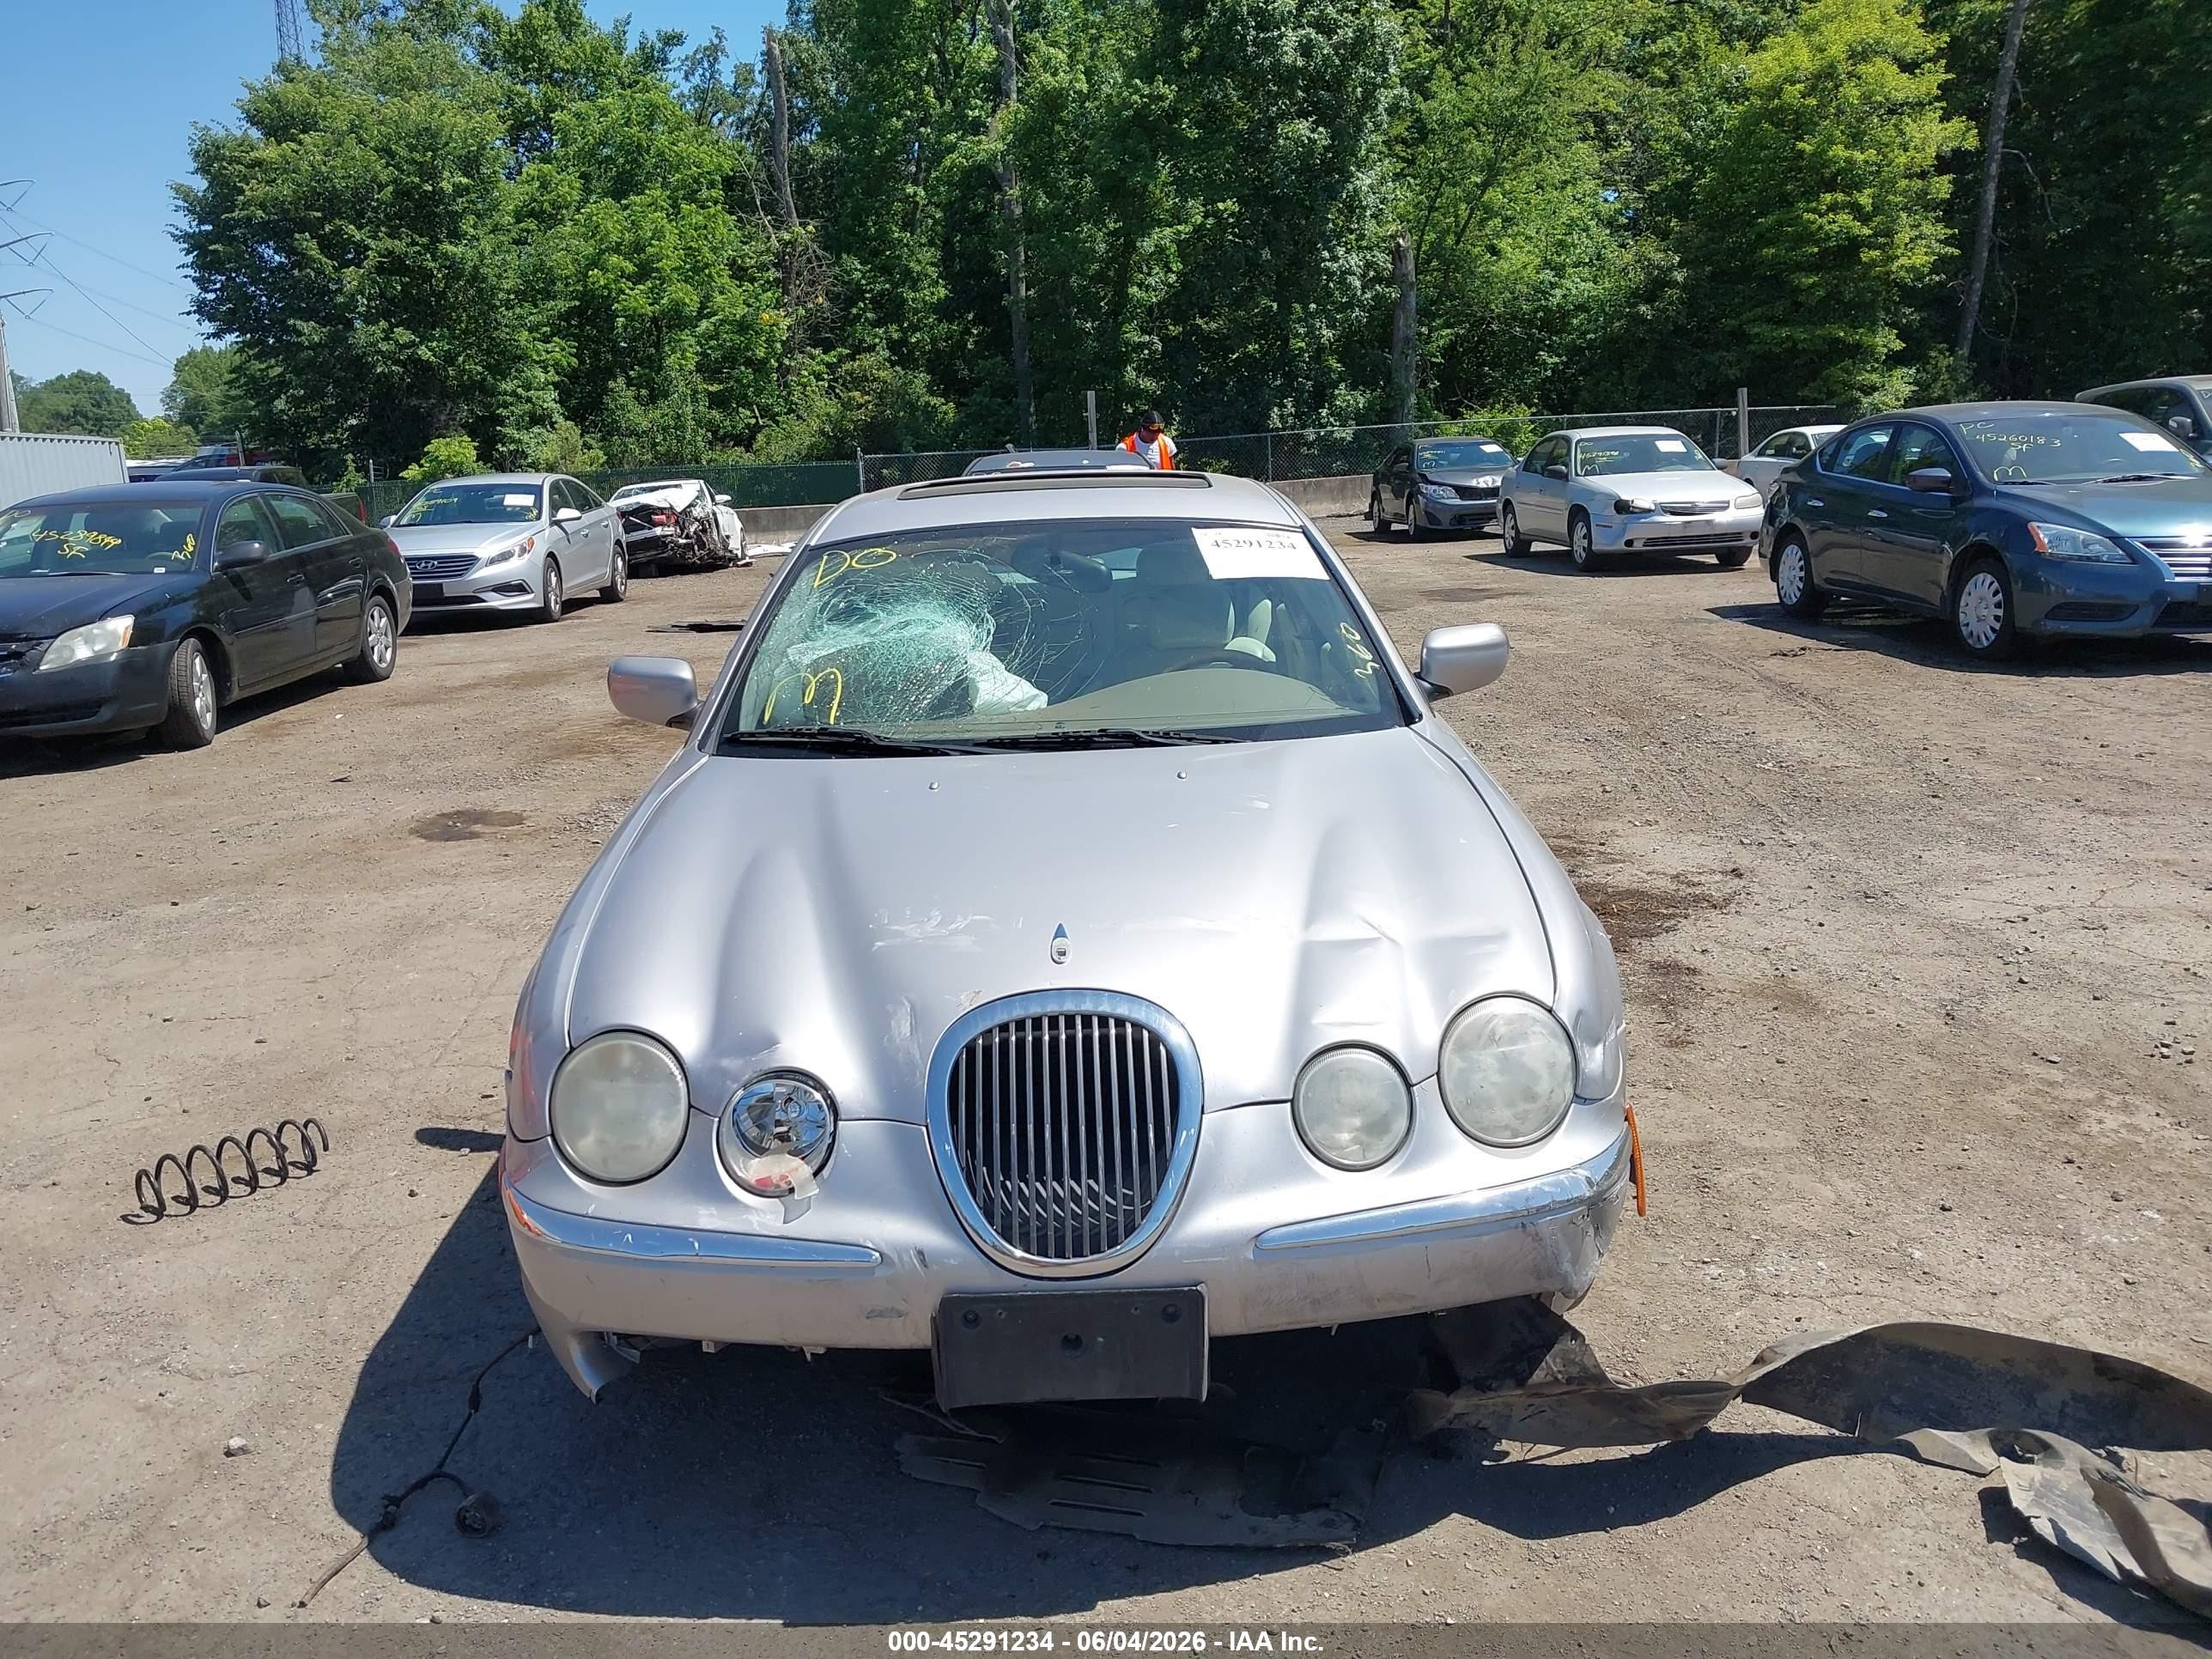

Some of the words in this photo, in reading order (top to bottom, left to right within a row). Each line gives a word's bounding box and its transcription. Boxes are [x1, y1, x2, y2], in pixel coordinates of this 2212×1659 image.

[1976, 433, 2061, 447] 45260183
[1211, 538, 1297, 550] 45291234
[813, 547, 897, 588] DO
